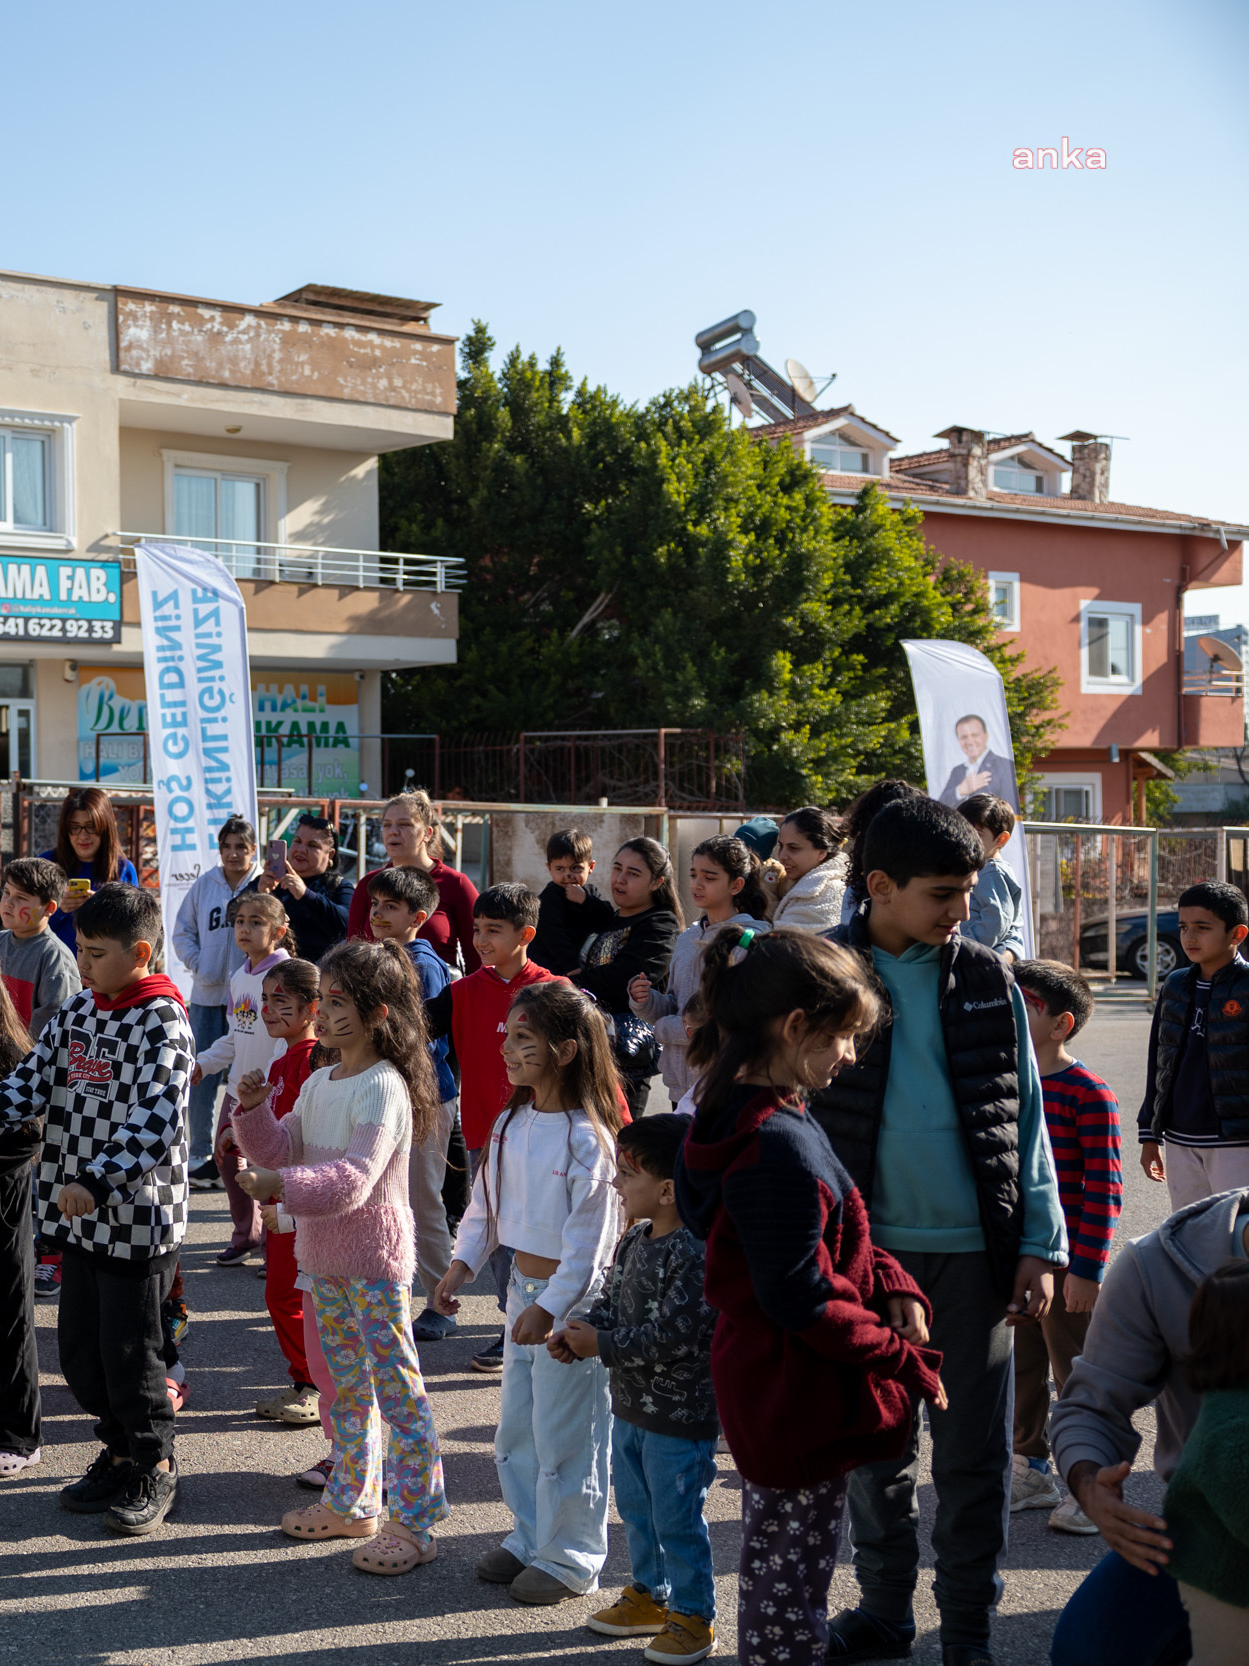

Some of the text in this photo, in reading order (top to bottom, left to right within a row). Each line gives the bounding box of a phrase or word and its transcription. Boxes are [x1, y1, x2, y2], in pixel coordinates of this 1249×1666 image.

[58, 565, 117, 604] FAB.
[27, 617, 63, 637] 622
[65, 619, 89, 638] 92
[92, 620, 114, 639] 33
[256, 684, 326, 713] HALI
[255, 720, 351, 748] IKAMA
[973, 998, 1007, 1009] Columbia
